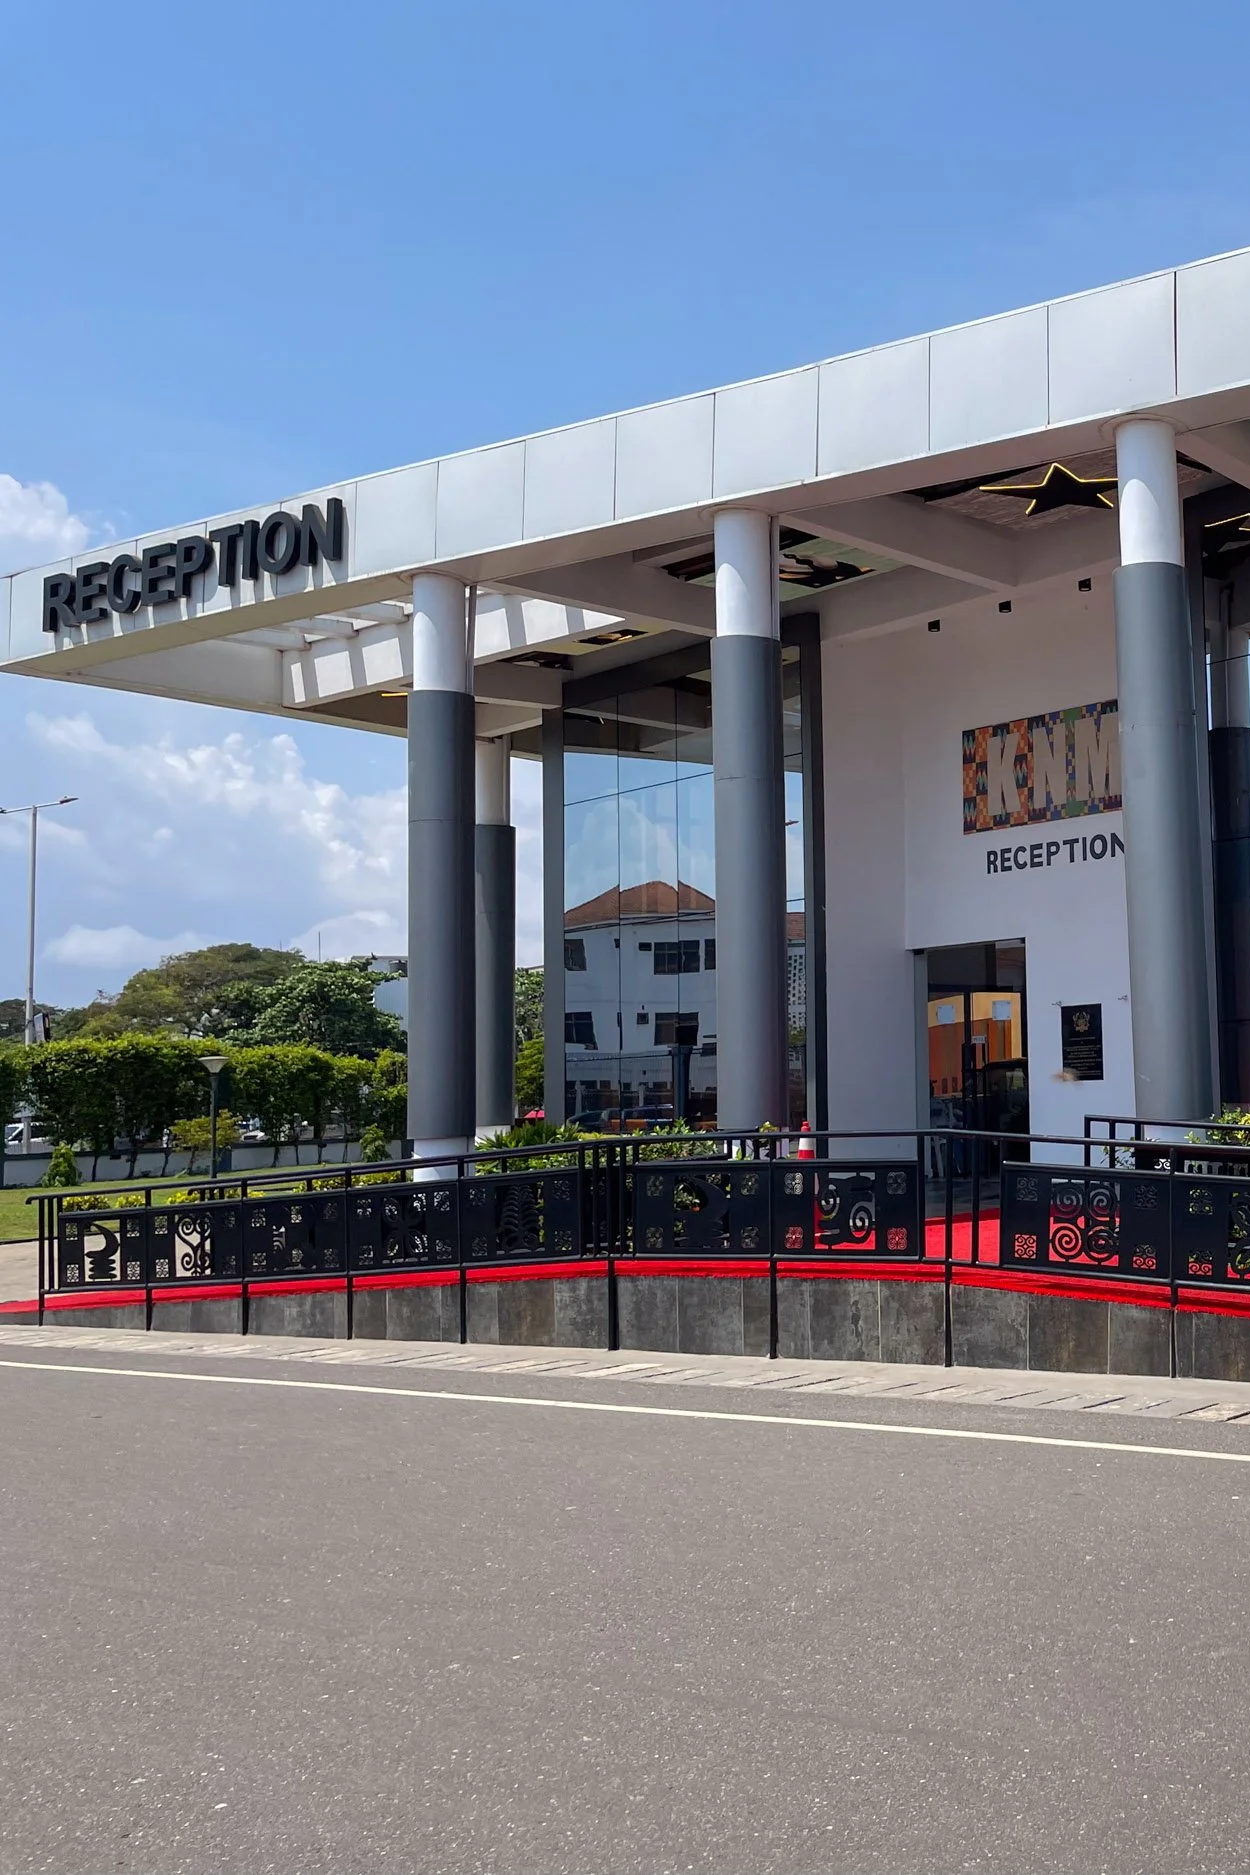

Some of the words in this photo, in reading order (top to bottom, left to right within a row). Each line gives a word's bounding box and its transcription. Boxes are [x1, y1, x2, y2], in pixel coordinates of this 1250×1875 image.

[42, 497, 343, 633] RECEPTION
[987, 712, 1122, 816] KNM
[987, 832, 1125, 875] RECEPTION
